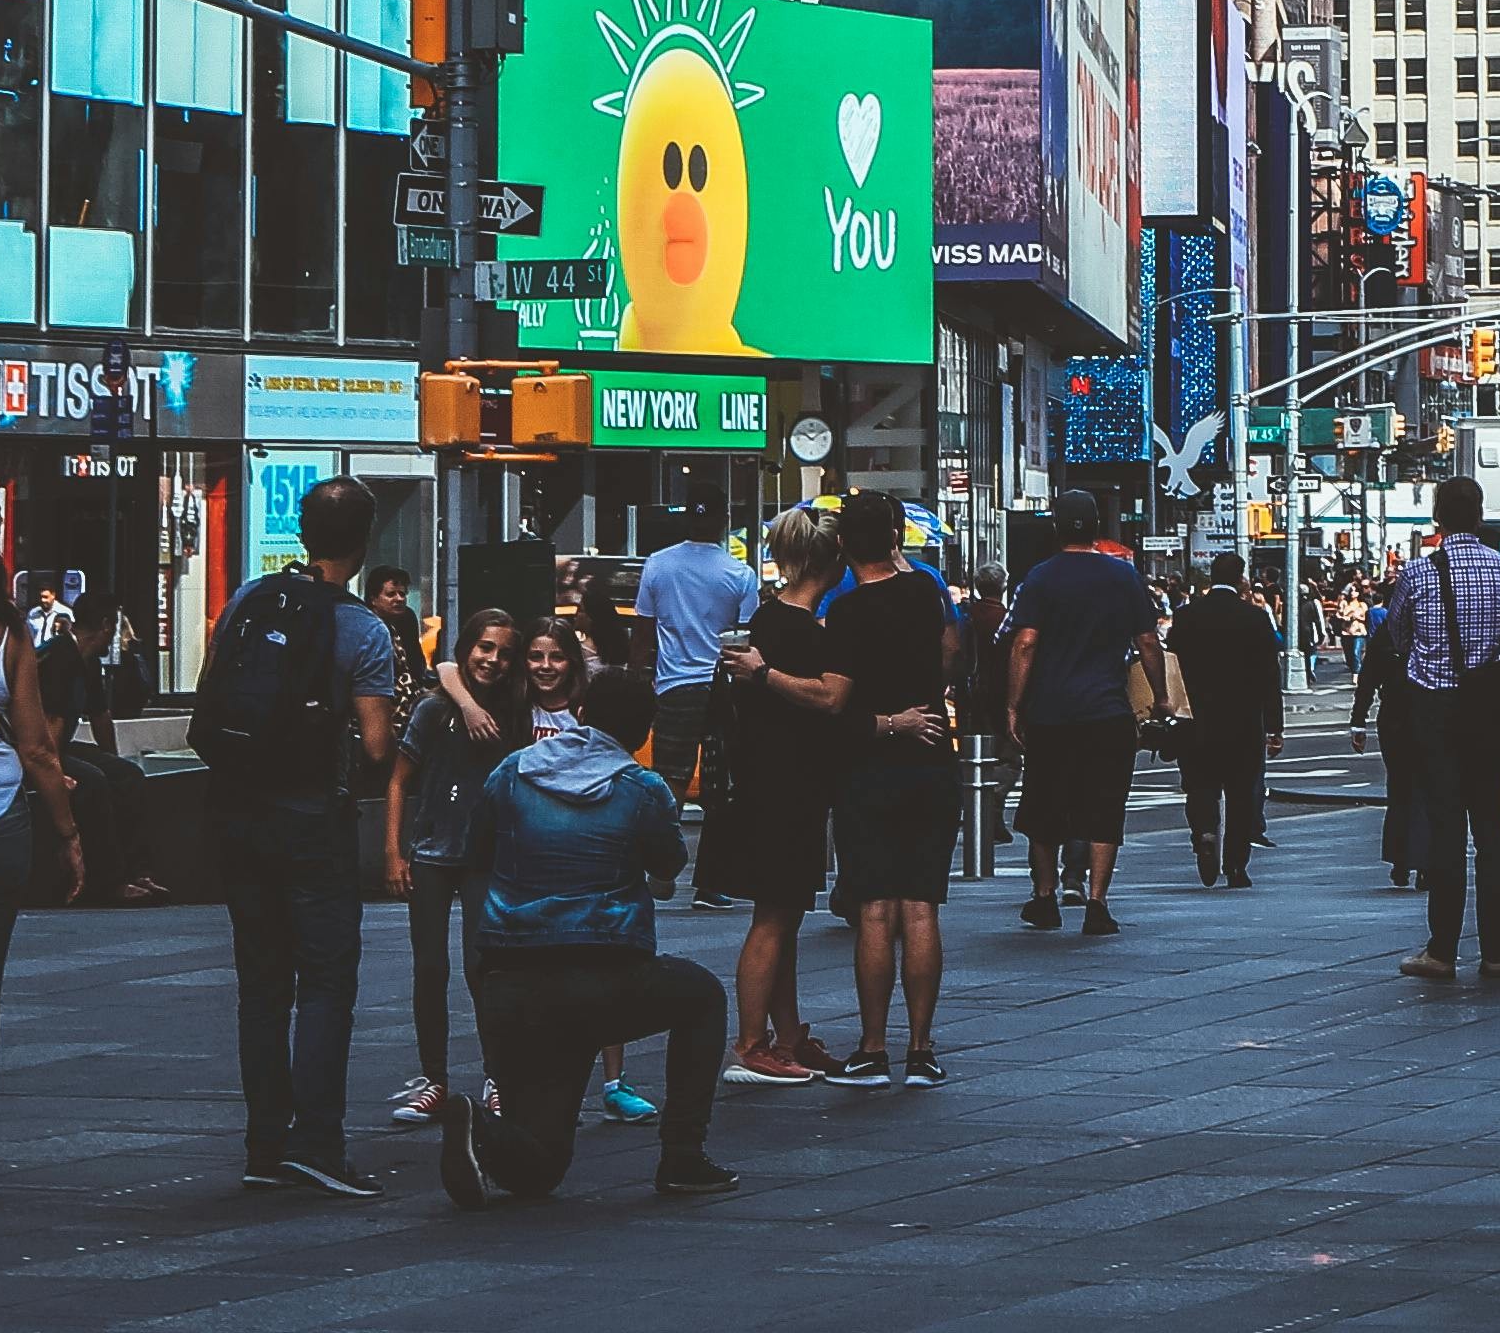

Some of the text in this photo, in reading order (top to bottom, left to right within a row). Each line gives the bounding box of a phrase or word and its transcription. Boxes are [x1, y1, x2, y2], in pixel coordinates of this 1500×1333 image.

[478, 195, 521, 219] WAY
[824, 185, 898, 273] YOU
[512, 265, 602, 294] W 44 St
[602, 389, 647, 429] NEW
[650, 389, 698, 431] YORK
